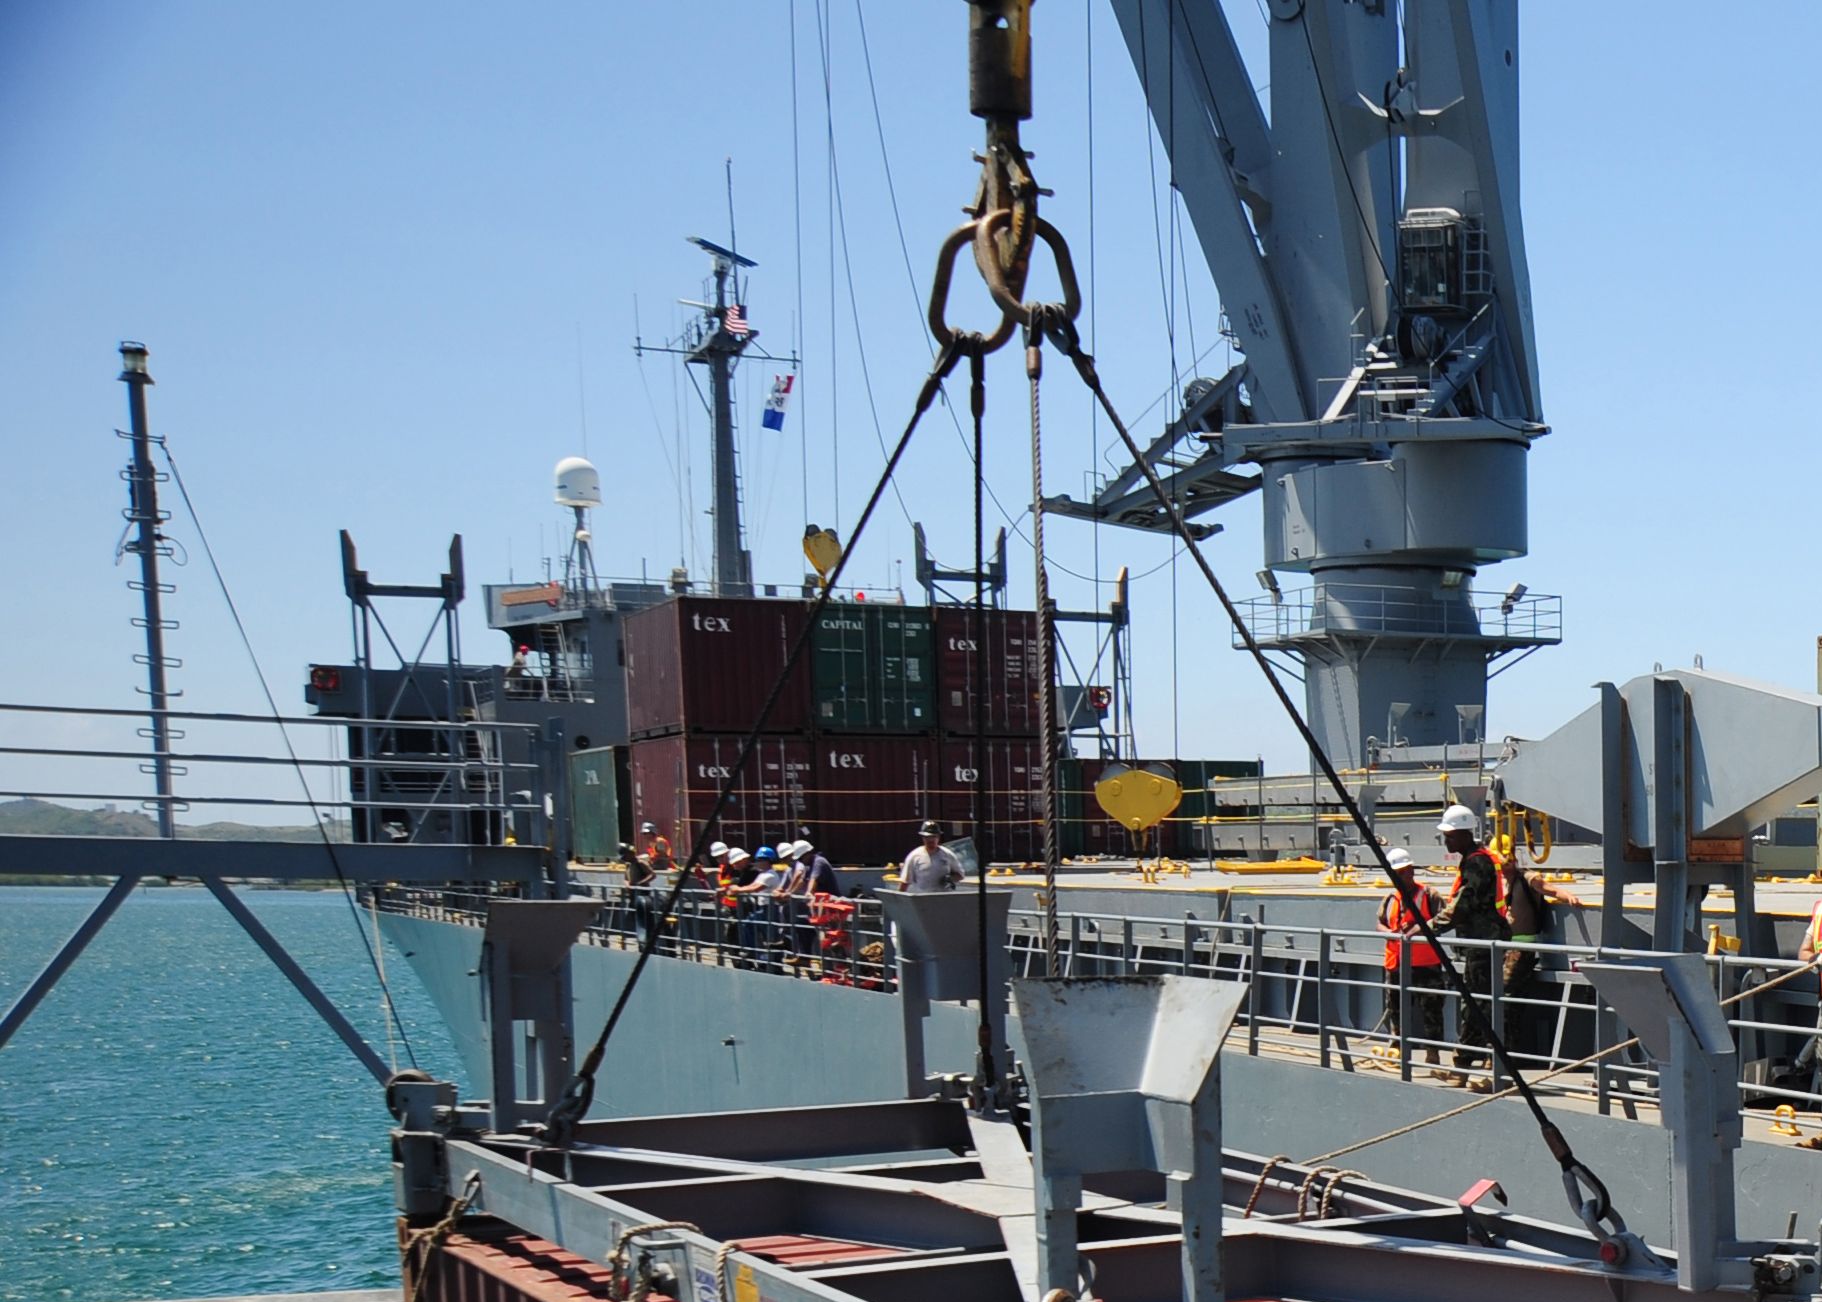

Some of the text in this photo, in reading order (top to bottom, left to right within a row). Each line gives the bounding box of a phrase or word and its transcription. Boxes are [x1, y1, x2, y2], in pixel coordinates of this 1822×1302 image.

[692, 612, 731, 632] tex
[821, 620, 864, 630] CAPITAL
[949, 638, 977, 651] tex
[829, 750, 866, 769] tex
[698, 764, 731, 778] tex
